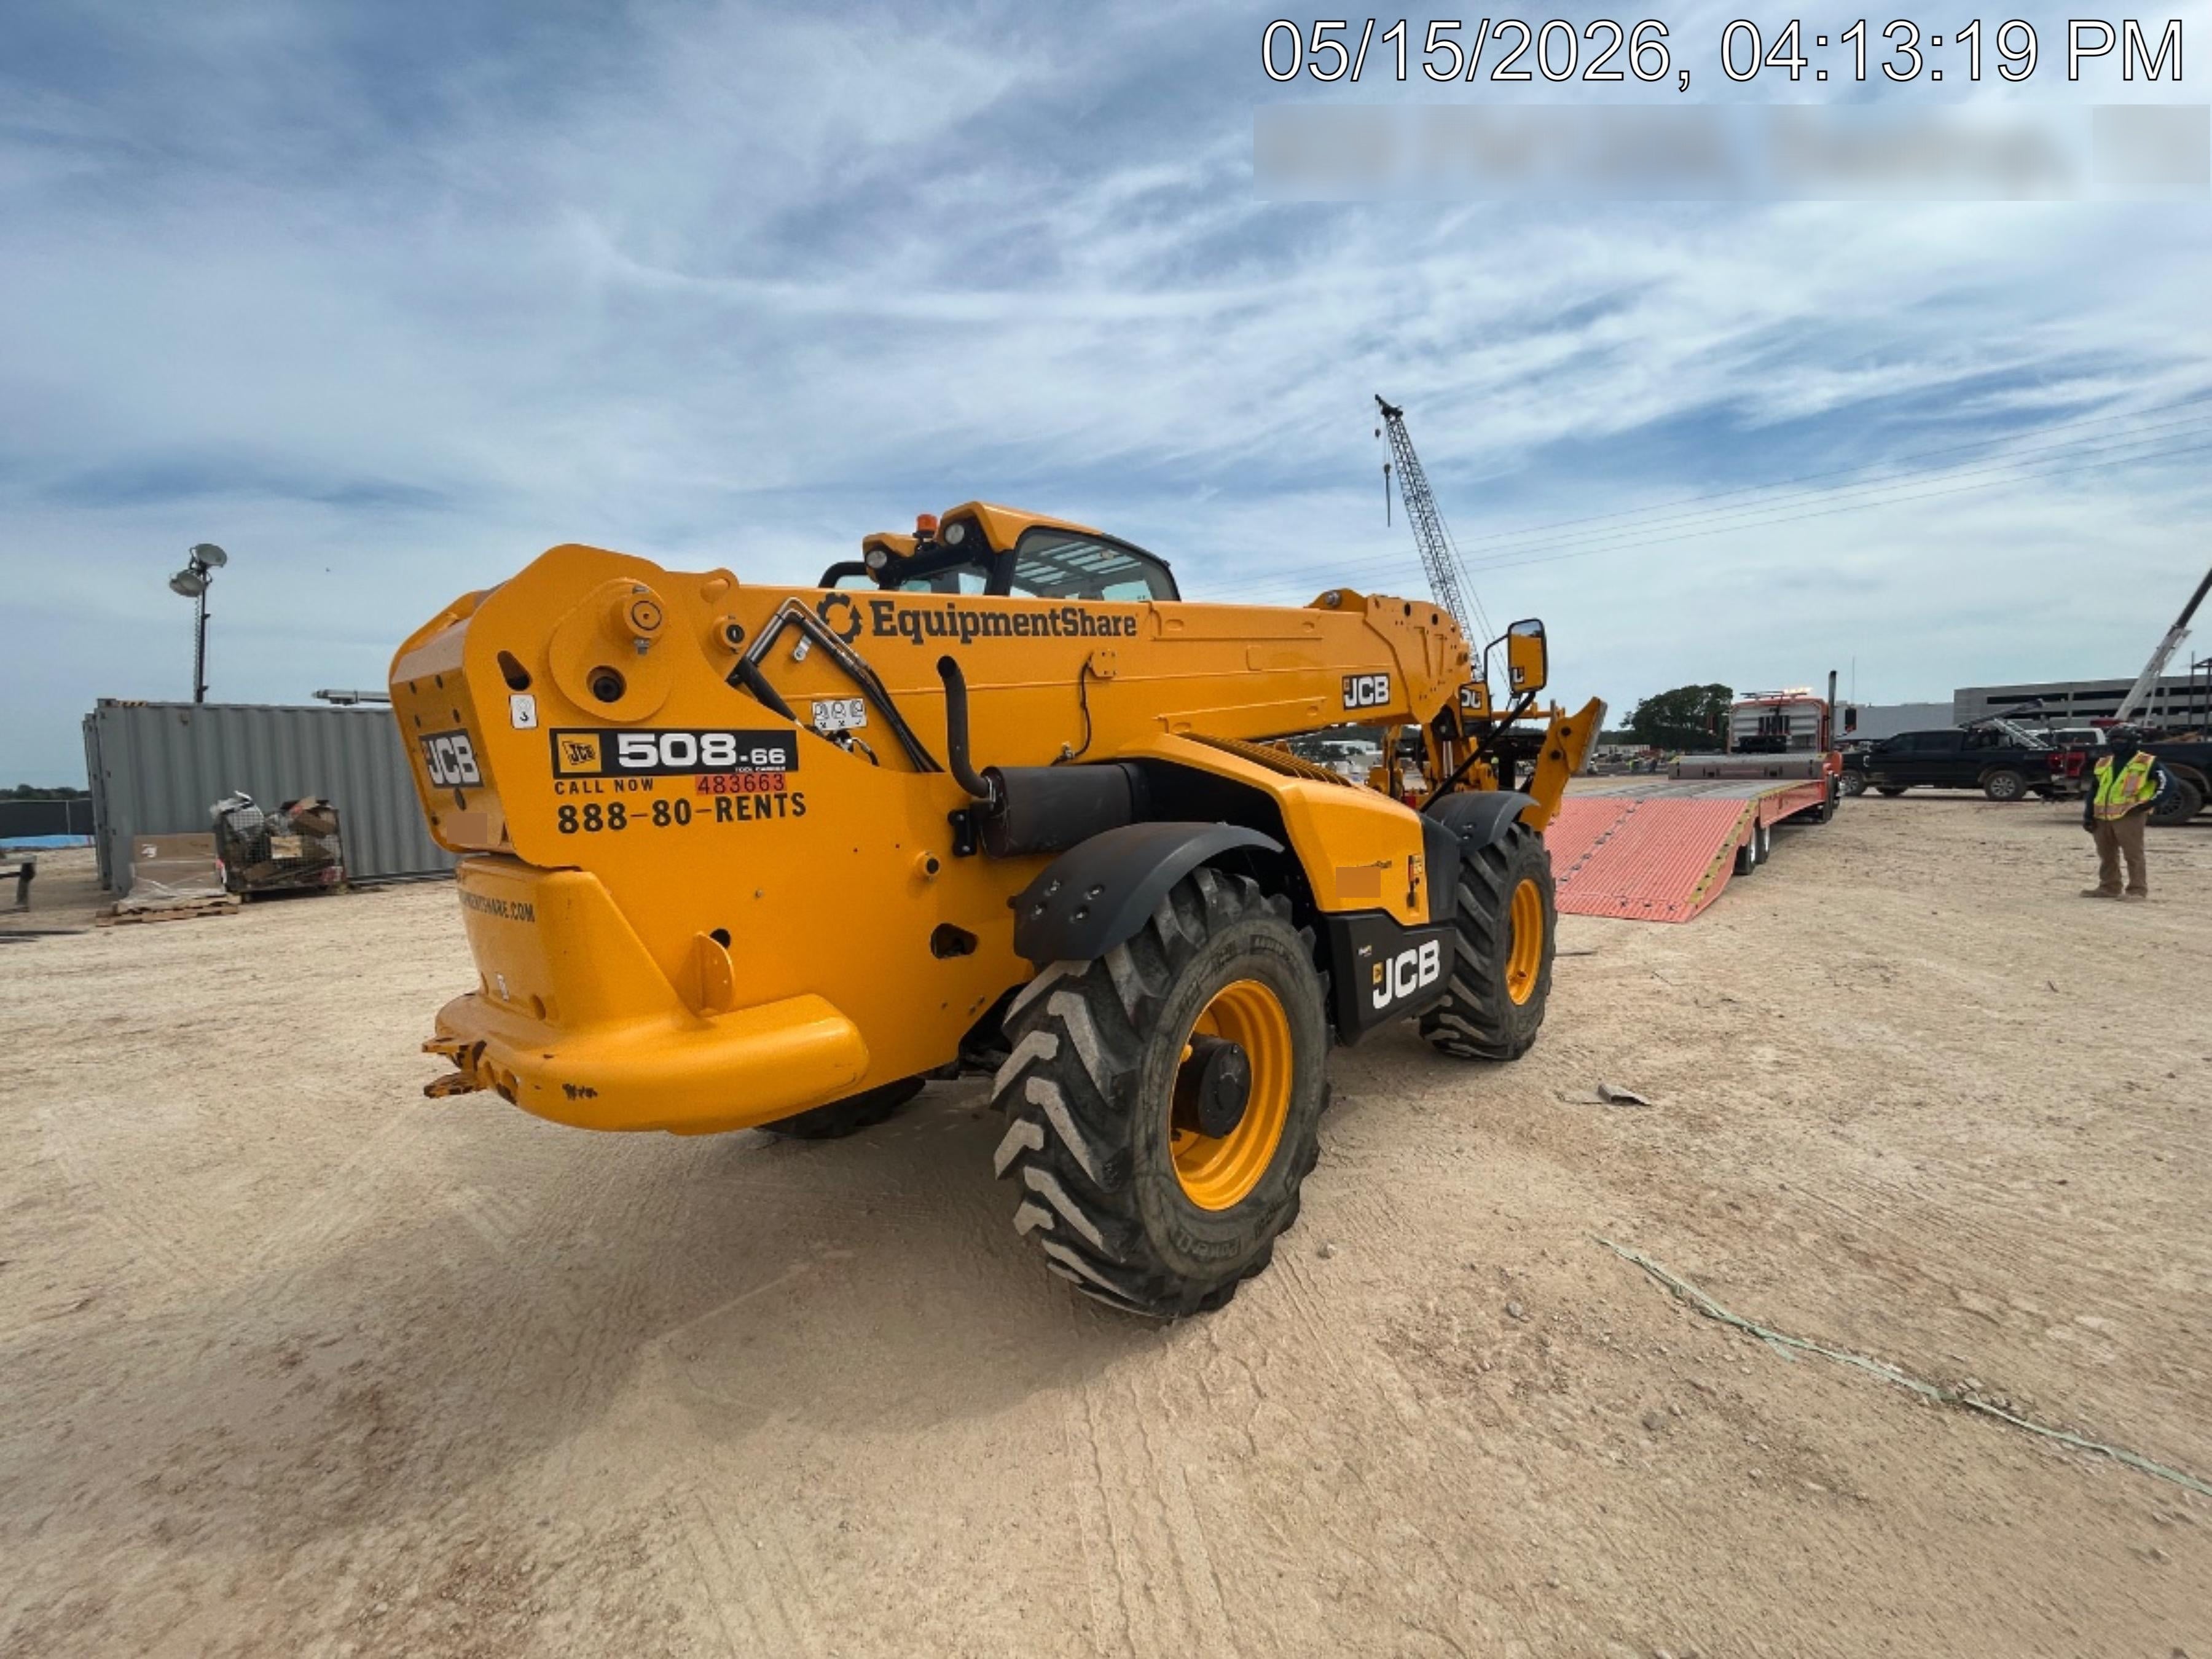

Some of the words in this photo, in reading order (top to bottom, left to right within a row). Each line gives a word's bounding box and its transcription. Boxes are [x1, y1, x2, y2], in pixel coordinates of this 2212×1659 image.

[868, 600, 1137, 645] EquipmentShare
[1344, 675, 1389, 707] JCB
[428, 734, 480, 785] JCB
[563, 741, 595, 764] JCB
[554, 780, 605, 796] CALL
[614, 777, 654, 793] NOW
[697, 774, 785, 794] 483663
[557, 791, 807, 834] 888-80-RENTS
[1372, 939, 1441, 1010] JCB
